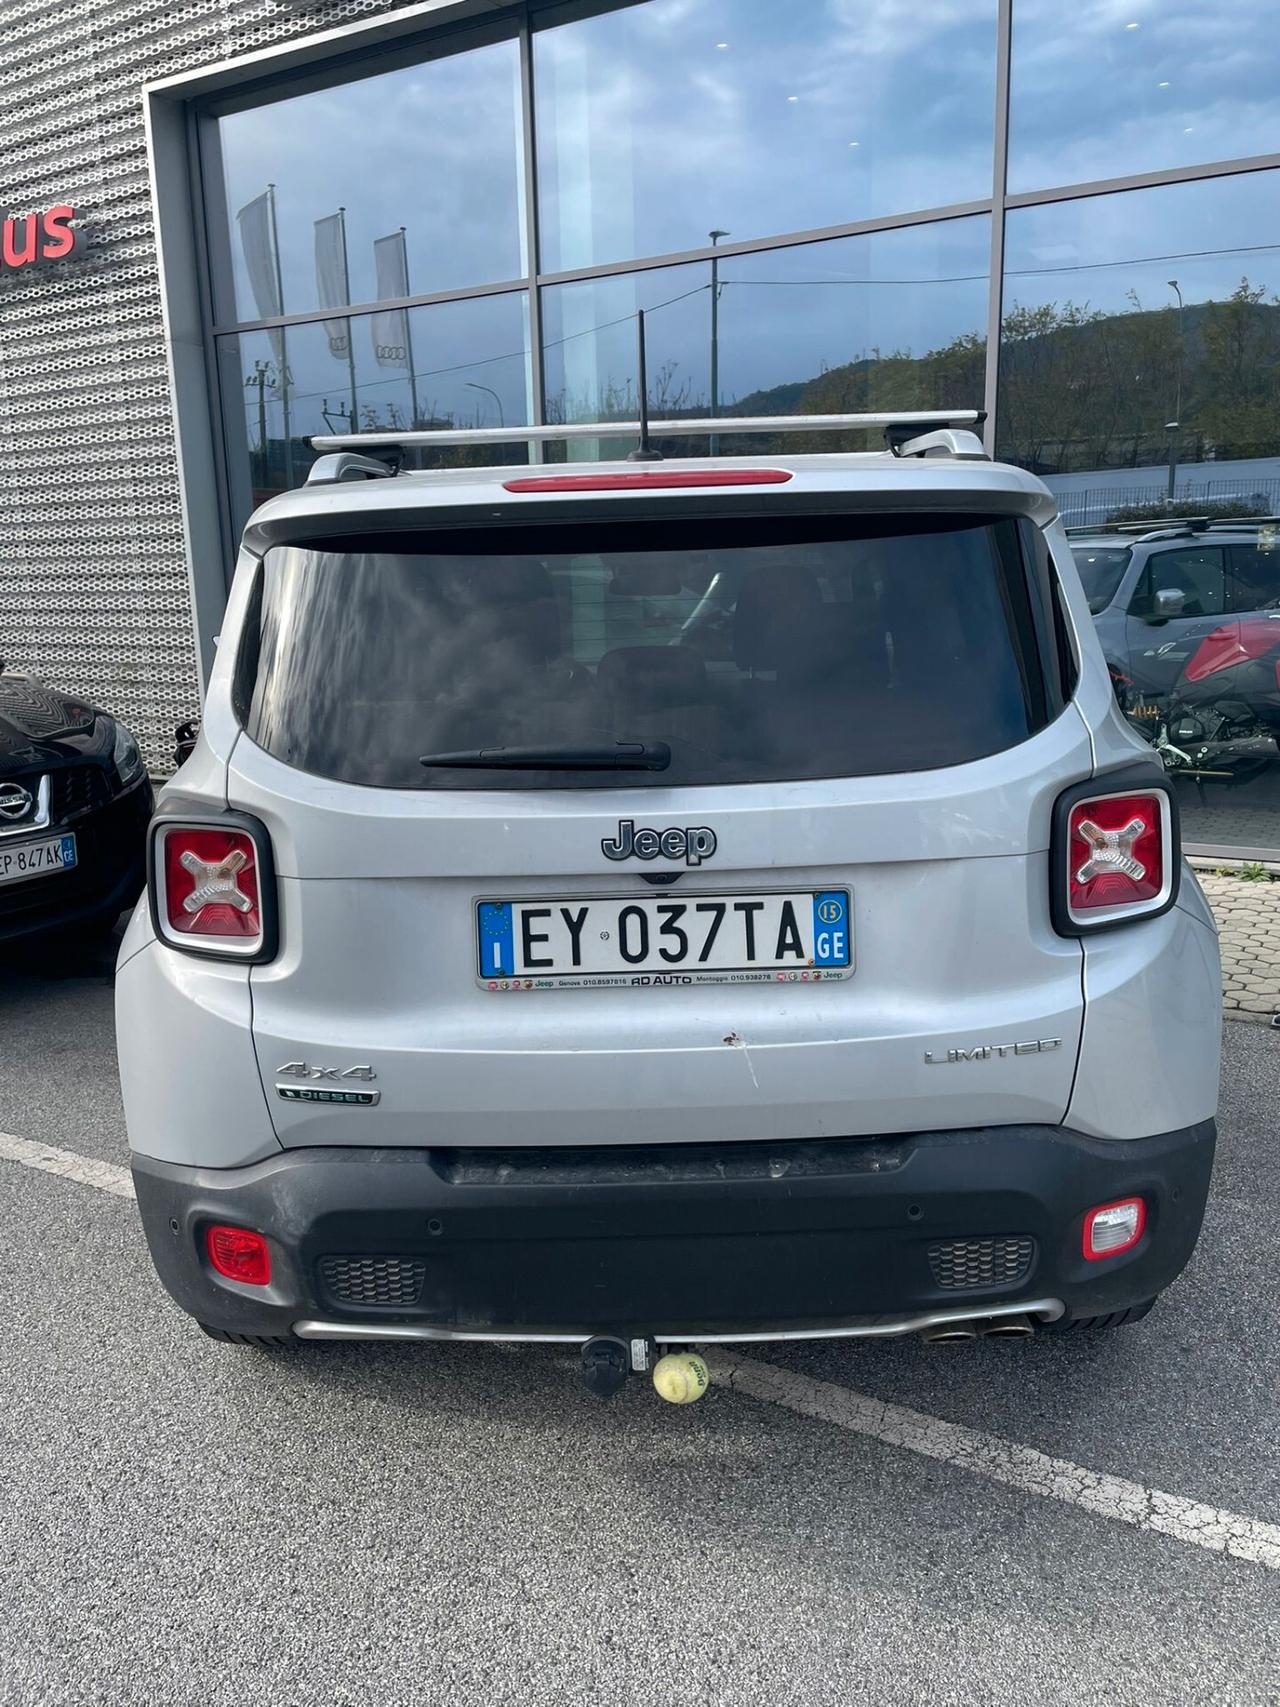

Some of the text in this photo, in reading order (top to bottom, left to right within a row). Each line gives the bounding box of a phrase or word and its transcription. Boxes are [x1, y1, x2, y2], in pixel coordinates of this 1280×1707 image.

[601, 820, 717, 866] Jeep
[17, 844, 62, 870] 847AK
[823, 904, 837, 919] 15
[521, 900, 805, 968] EY 037TA
[817, 931, 844, 958] GE
[535, 980, 554, 988] Jeep
[653, 975, 693, 985] AUTO
[823, 971, 843, 979] Jeep
[924, 1037, 1062, 1064] LIMITED
[276, 1061, 377, 1081] 4x4
[299, 1090, 370, 1103] DIESEL
